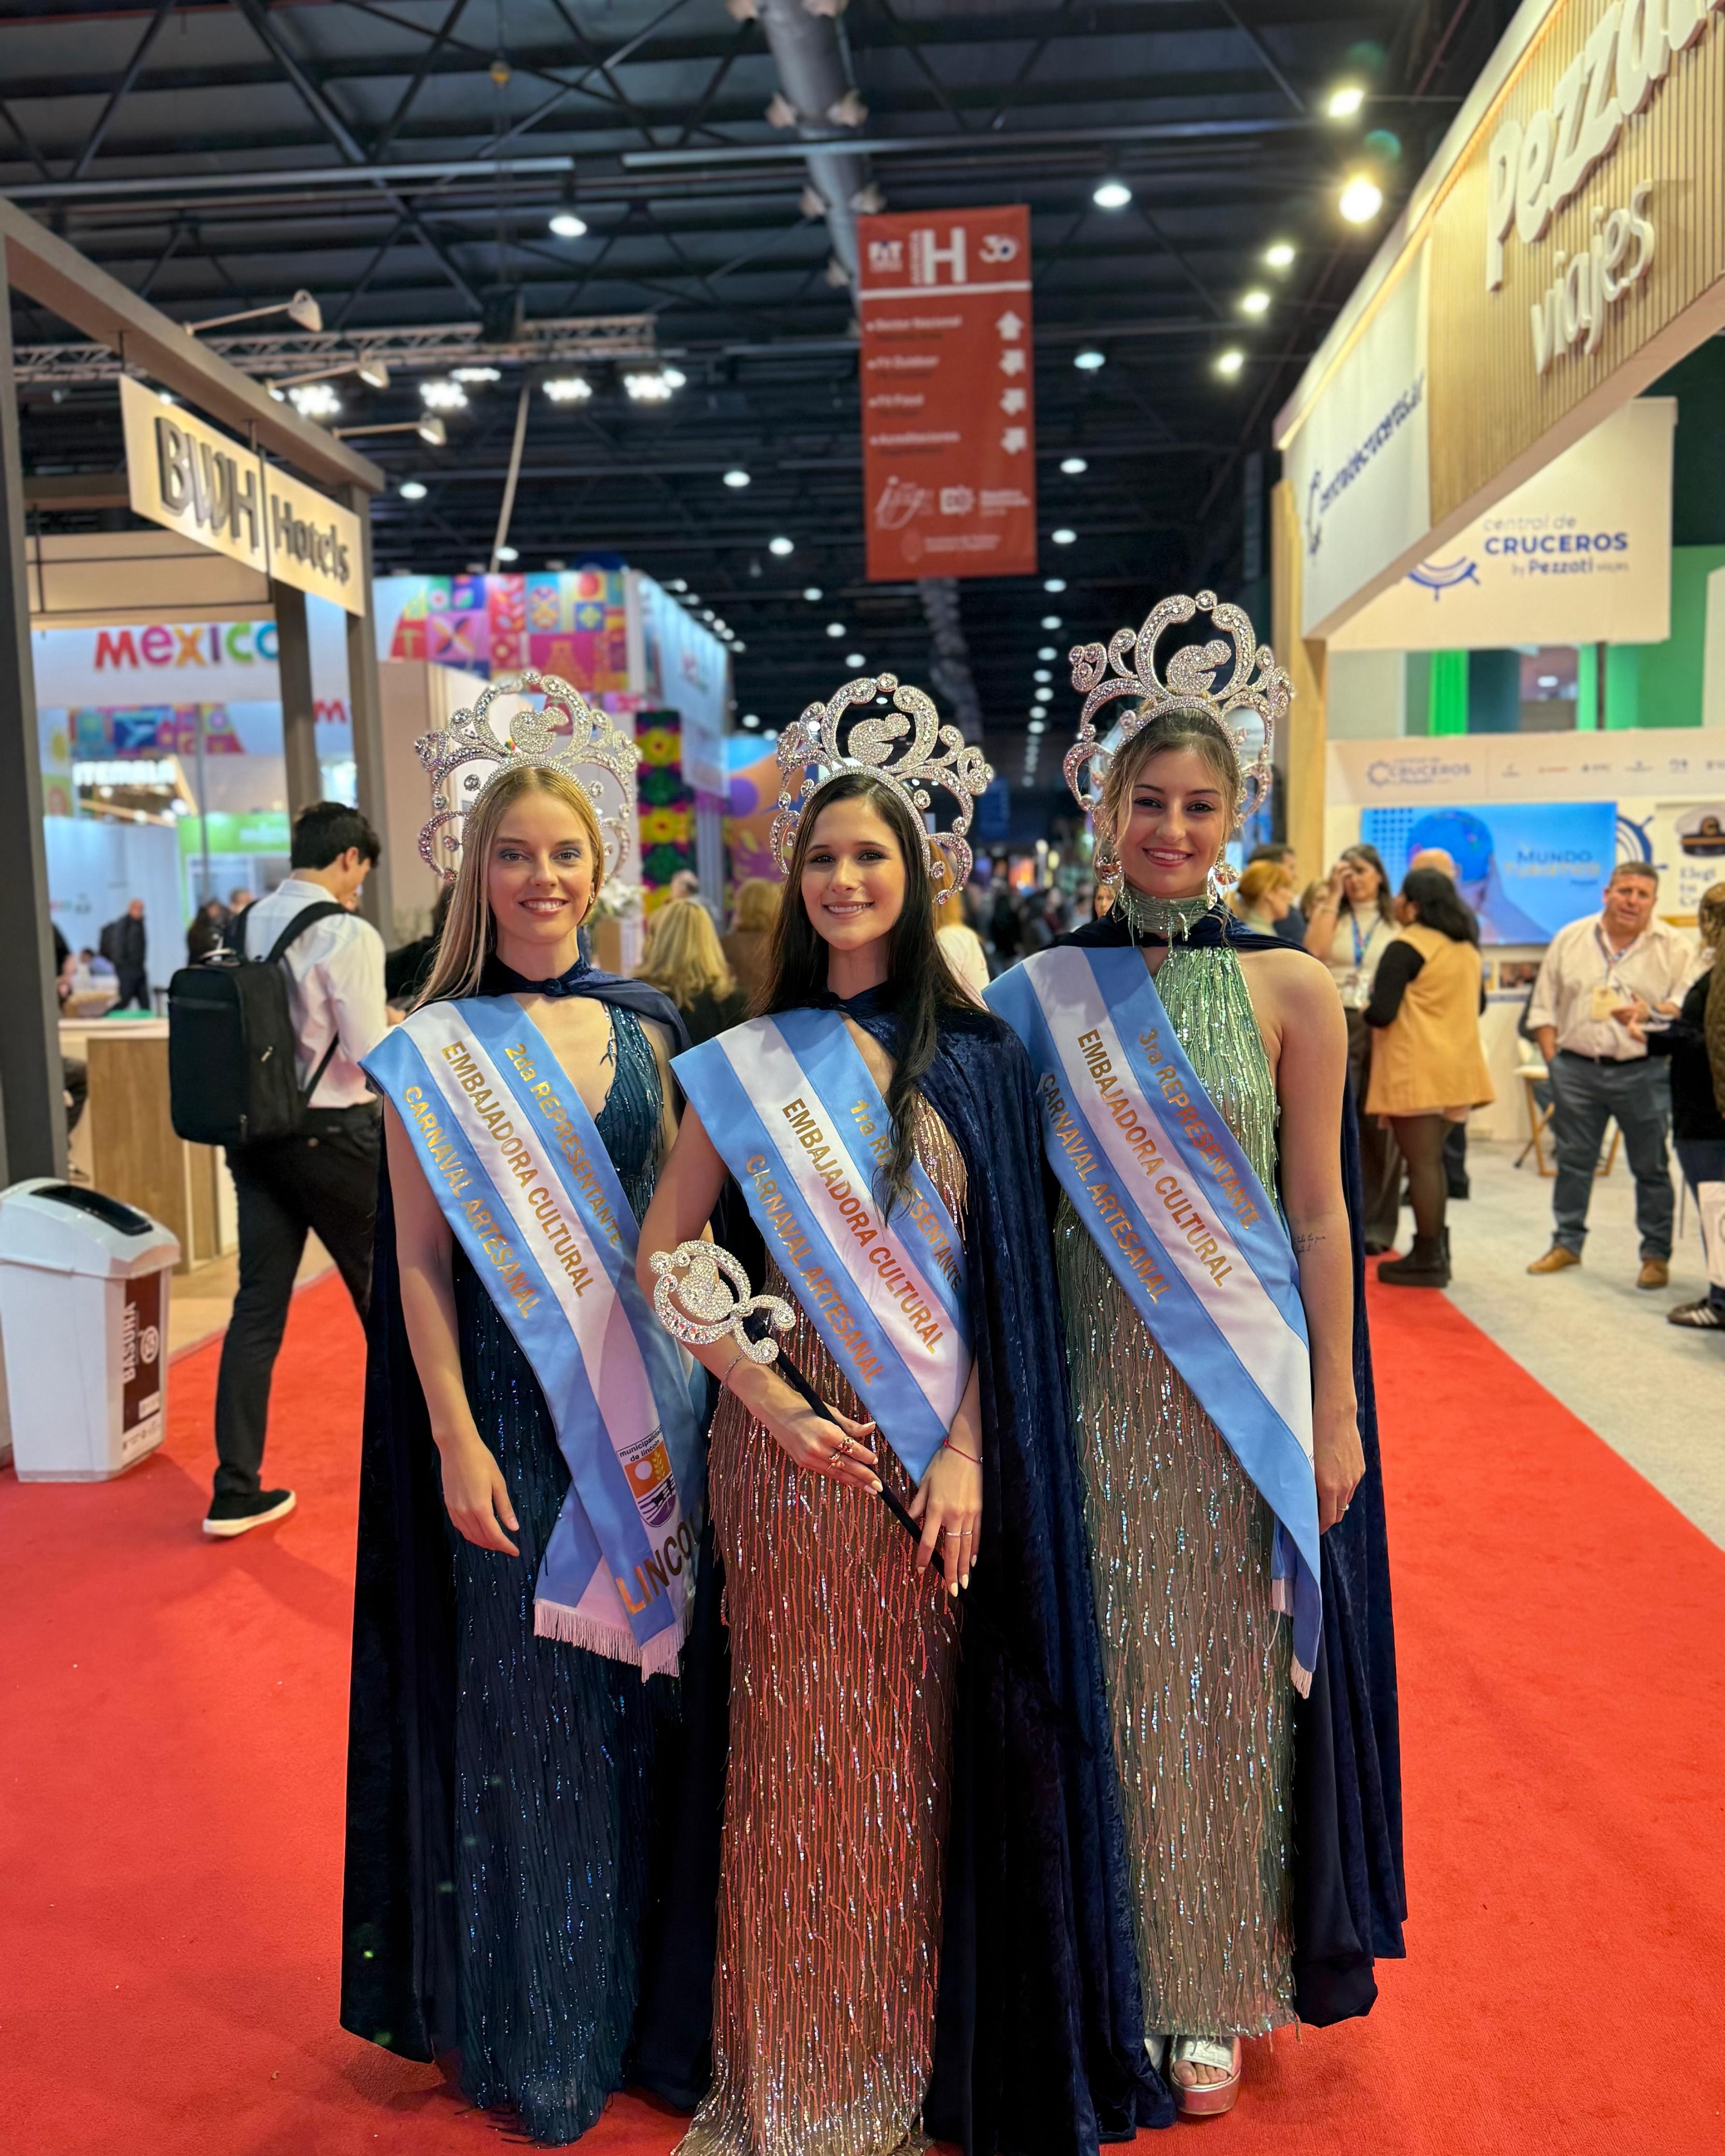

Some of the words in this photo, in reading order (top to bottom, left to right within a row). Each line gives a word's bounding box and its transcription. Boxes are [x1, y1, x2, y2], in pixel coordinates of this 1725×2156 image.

[922, 226, 967, 285] H
[1531, 179, 1655, 376] viajes
[156, 417, 259, 552] BWH
[271, 495, 349, 586] Hotels
[1485, 532, 1629, 555] CRUCEROS
[1529, 557, 1594, 575] Pezzati
[1517, 849, 1592, 864] MUNDO
[404, 1086, 473, 1198] CARNAVAL
[461, 1198, 541, 1318] ARTESANAL
[441, 1041, 538, 1188] EMBAJADORA
[528, 1187, 595, 1297] CULTURAL
[505, 1044, 536, 1081] 2da
[530, 1081, 621, 1247] REPRESENTANTE
[851, 1100, 875, 1137] 1ra
[1040, 1073, 1099, 1181] CARNAVAL
[1087, 1183, 1172, 1304] ARTESANAL
[1078, 1029, 1165, 1177] EMBAJADORA
[1155, 1176, 1233, 1287] CULTURAL
[1139, 1028, 1163, 1066] 3ra
[1155, 1066, 1260, 1230] REPRESENTANTE
[746, 1155, 812, 1269] CARNAVAL
[801, 1266, 885, 1385] ARTESANAL
[782, 1098, 878, 1247] EMBAJADORA
[869, 1247, 945, 1354] CULTURAL
